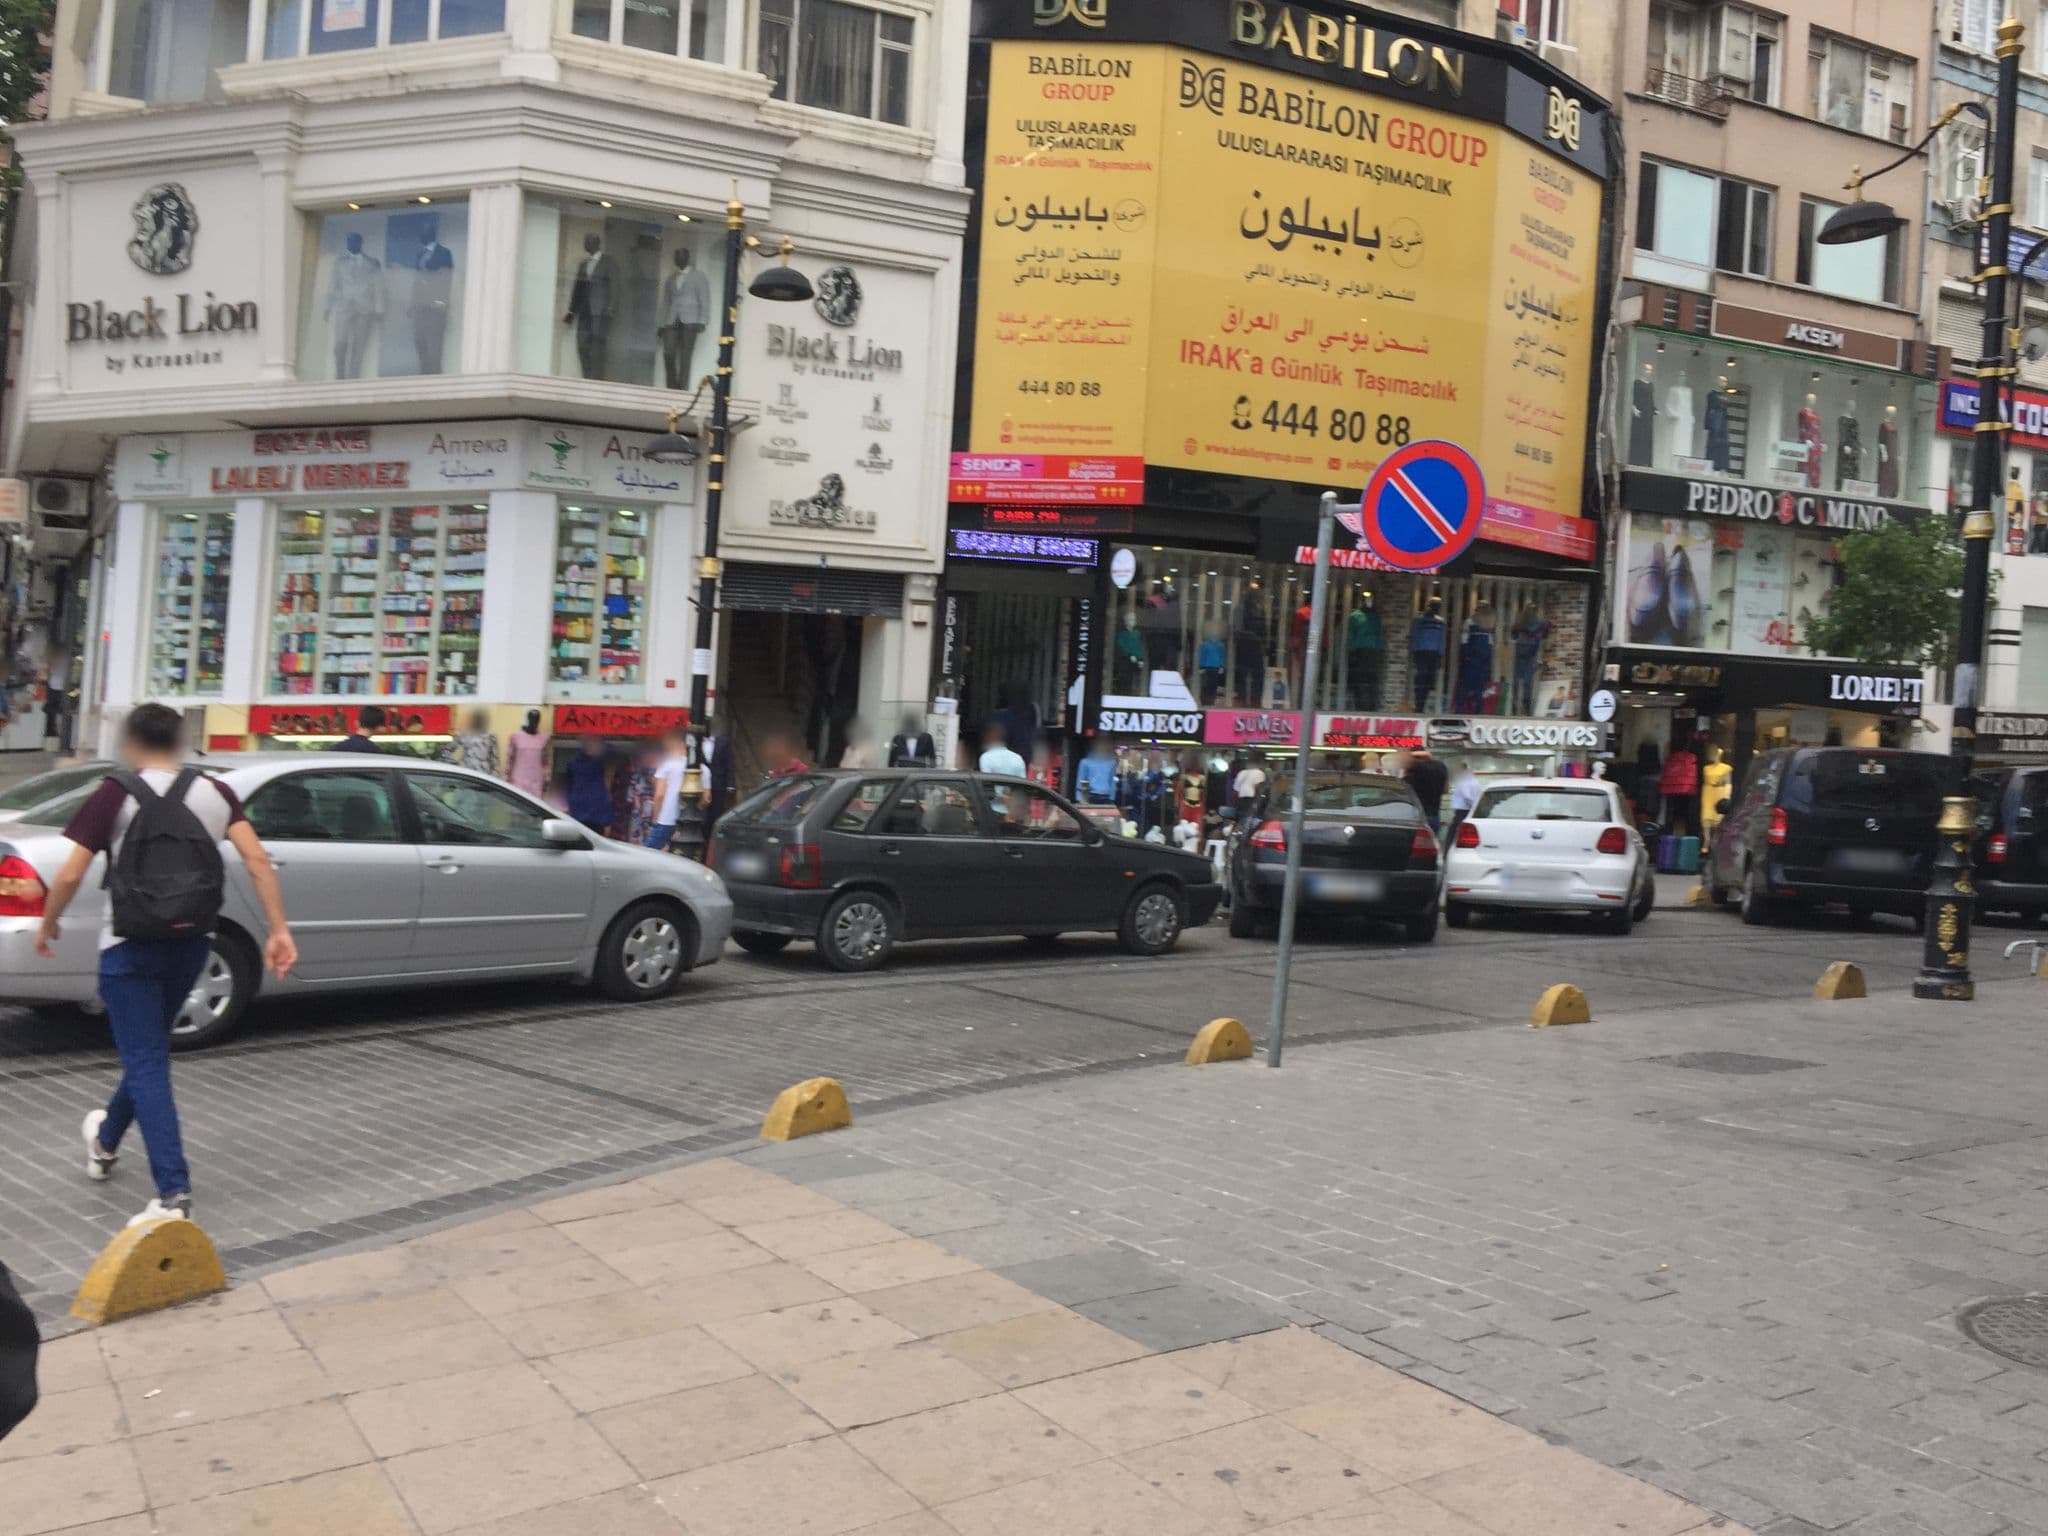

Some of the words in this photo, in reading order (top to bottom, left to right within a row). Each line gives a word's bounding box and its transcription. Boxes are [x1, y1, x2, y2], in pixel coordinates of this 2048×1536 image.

[1041, 82, 1115, 101] GROUP
[1016, 119, 1136, 137] ULUSLARARASI
[1385, 117, 1488, 168] GROUP
[1217, 129, 1348, 173] ULUSLARARASI
[1354, 159, 1453, 197] TAŞIMACILIK
[994, 195, 1109, 232] بابيلون
[1240, 189, 1382, 263] بابيلون
[66, 297, 166, 342] Black
[176, 291, 259, 336] Lion
[767, 323, 838, 362] Black
[848, 335, 903, 368] Lion
[1019, 380, 1049, 396] 444
[1055, 381, 1076, 396] 80
[1080, 382, 1102, 397] 88
[1271, 354, 1343, 387] Günlük
[1354, 367, 1457, 402] Taşımacılık
[1262, 399, 1319, 438] 444
[1329, 407, 1366, 443] 80
[1375, 413, 1411, 448] 88
[428, 434, 508, 455] Аптека
[1688, 482, 1774, 520] PEDRO
[1100, 711, 1198, 733] SEABECO
